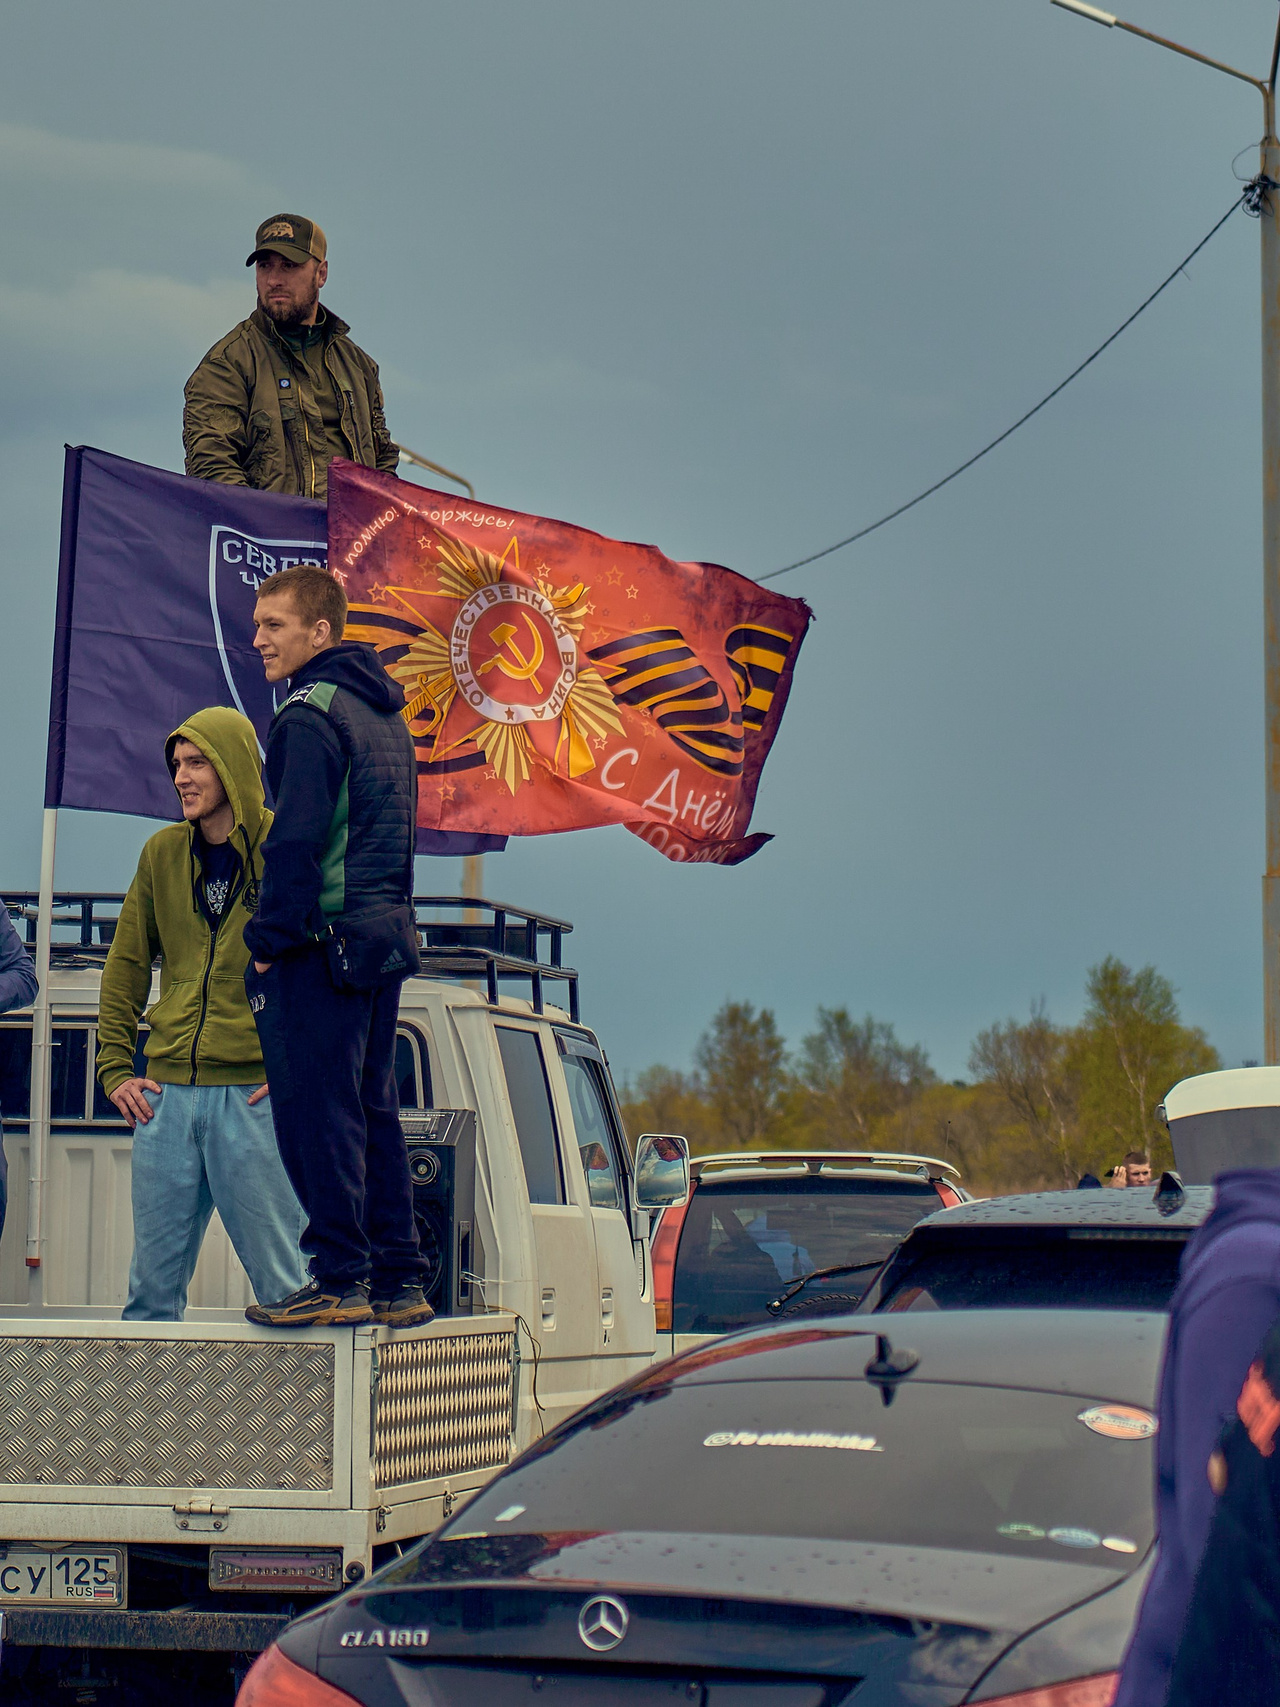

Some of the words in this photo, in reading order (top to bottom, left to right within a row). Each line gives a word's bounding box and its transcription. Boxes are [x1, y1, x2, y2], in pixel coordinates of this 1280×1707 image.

[332, 567, 349, 587] Я
[345, 506, 400, 566] помню!
[403, 502, 419, 516] Я
[452, 584, 570, 707] ОТЕЧЕСТВЕННАЯ
[531, 651, 575, 719] ВОЙНА
[600, 748, 639, 790] С
[641, 768, 738, 840] Днём
[380, 960, 407, 974] adidas
[55, 1557, 110, 1587] 125
[66, 1586, 93, 1598] RUS
[340, 1630, 385, 1648] CLA
[388, 1629, 430, 1648] 180
